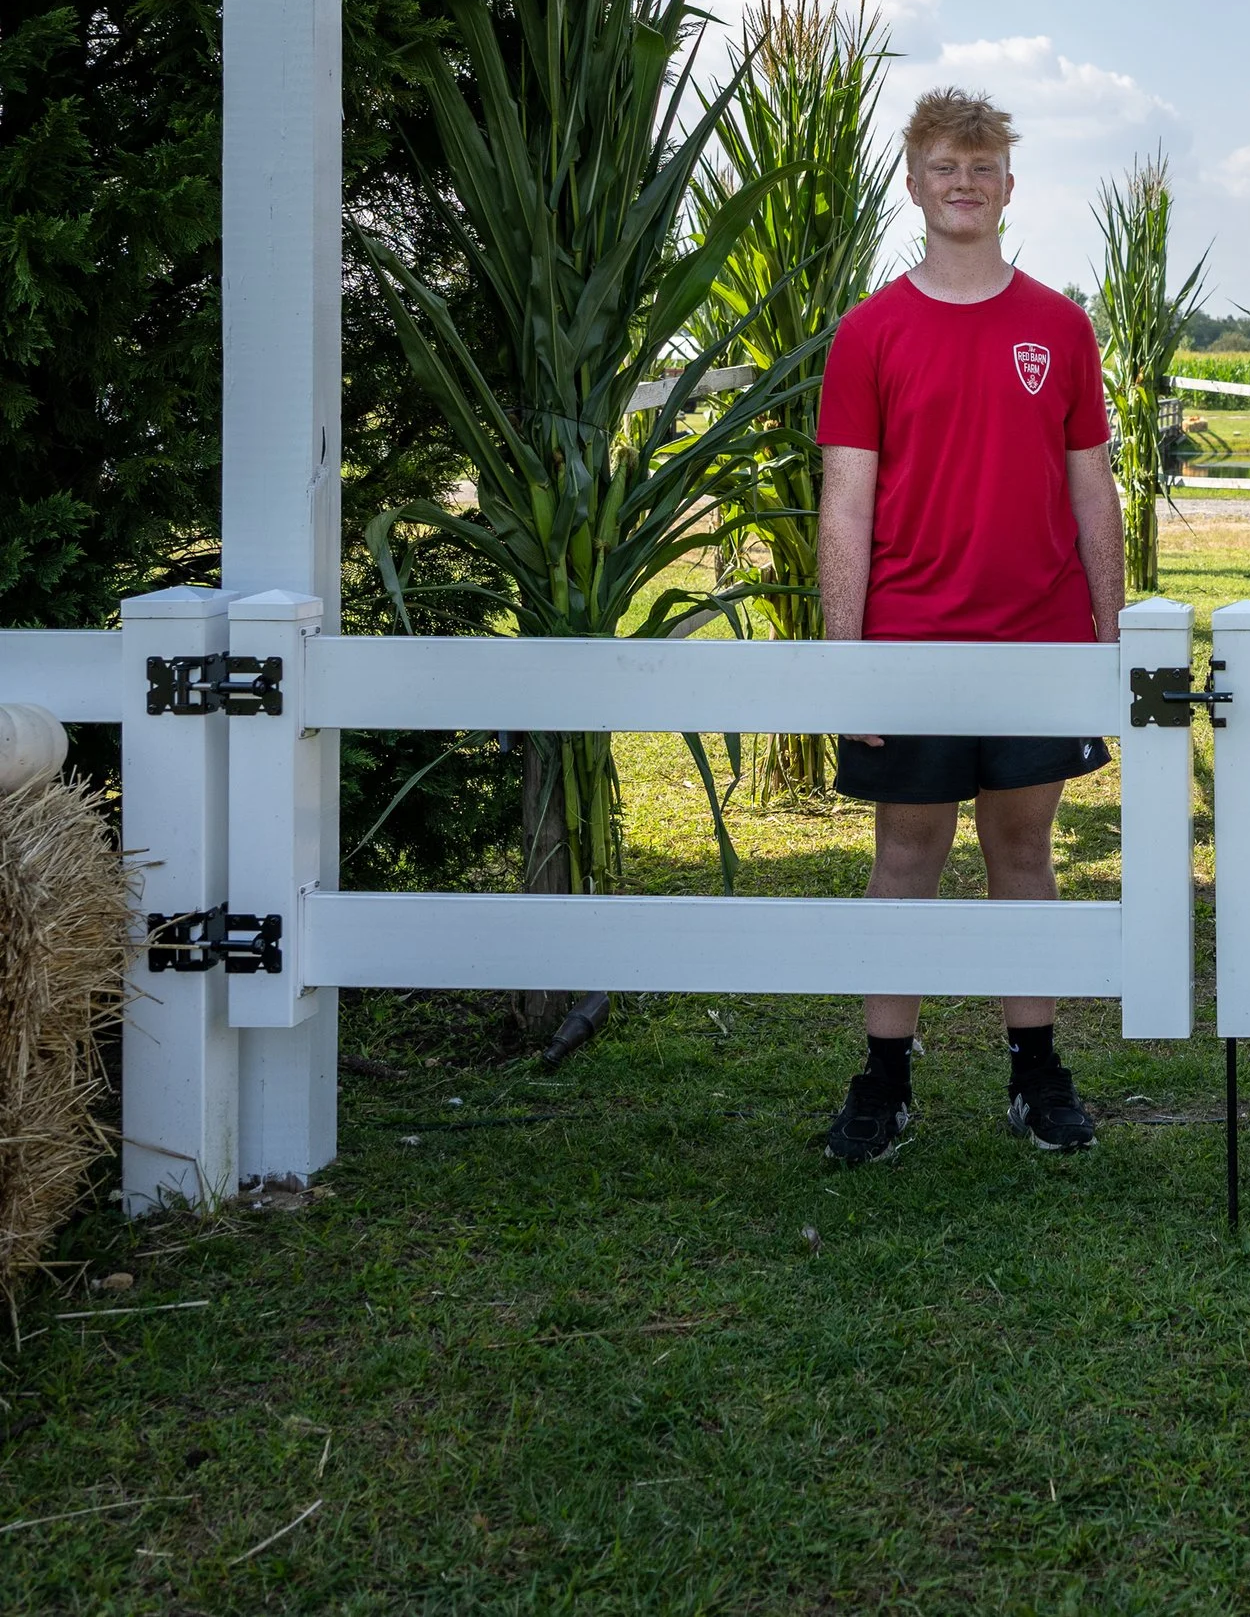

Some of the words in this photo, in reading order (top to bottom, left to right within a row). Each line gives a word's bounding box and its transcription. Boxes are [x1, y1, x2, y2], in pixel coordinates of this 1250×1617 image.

[1018, 351, 1030, 363] RED
[1030, 352, 1047, 365] BARN
[1023, 363, 1041, 376] FARM
